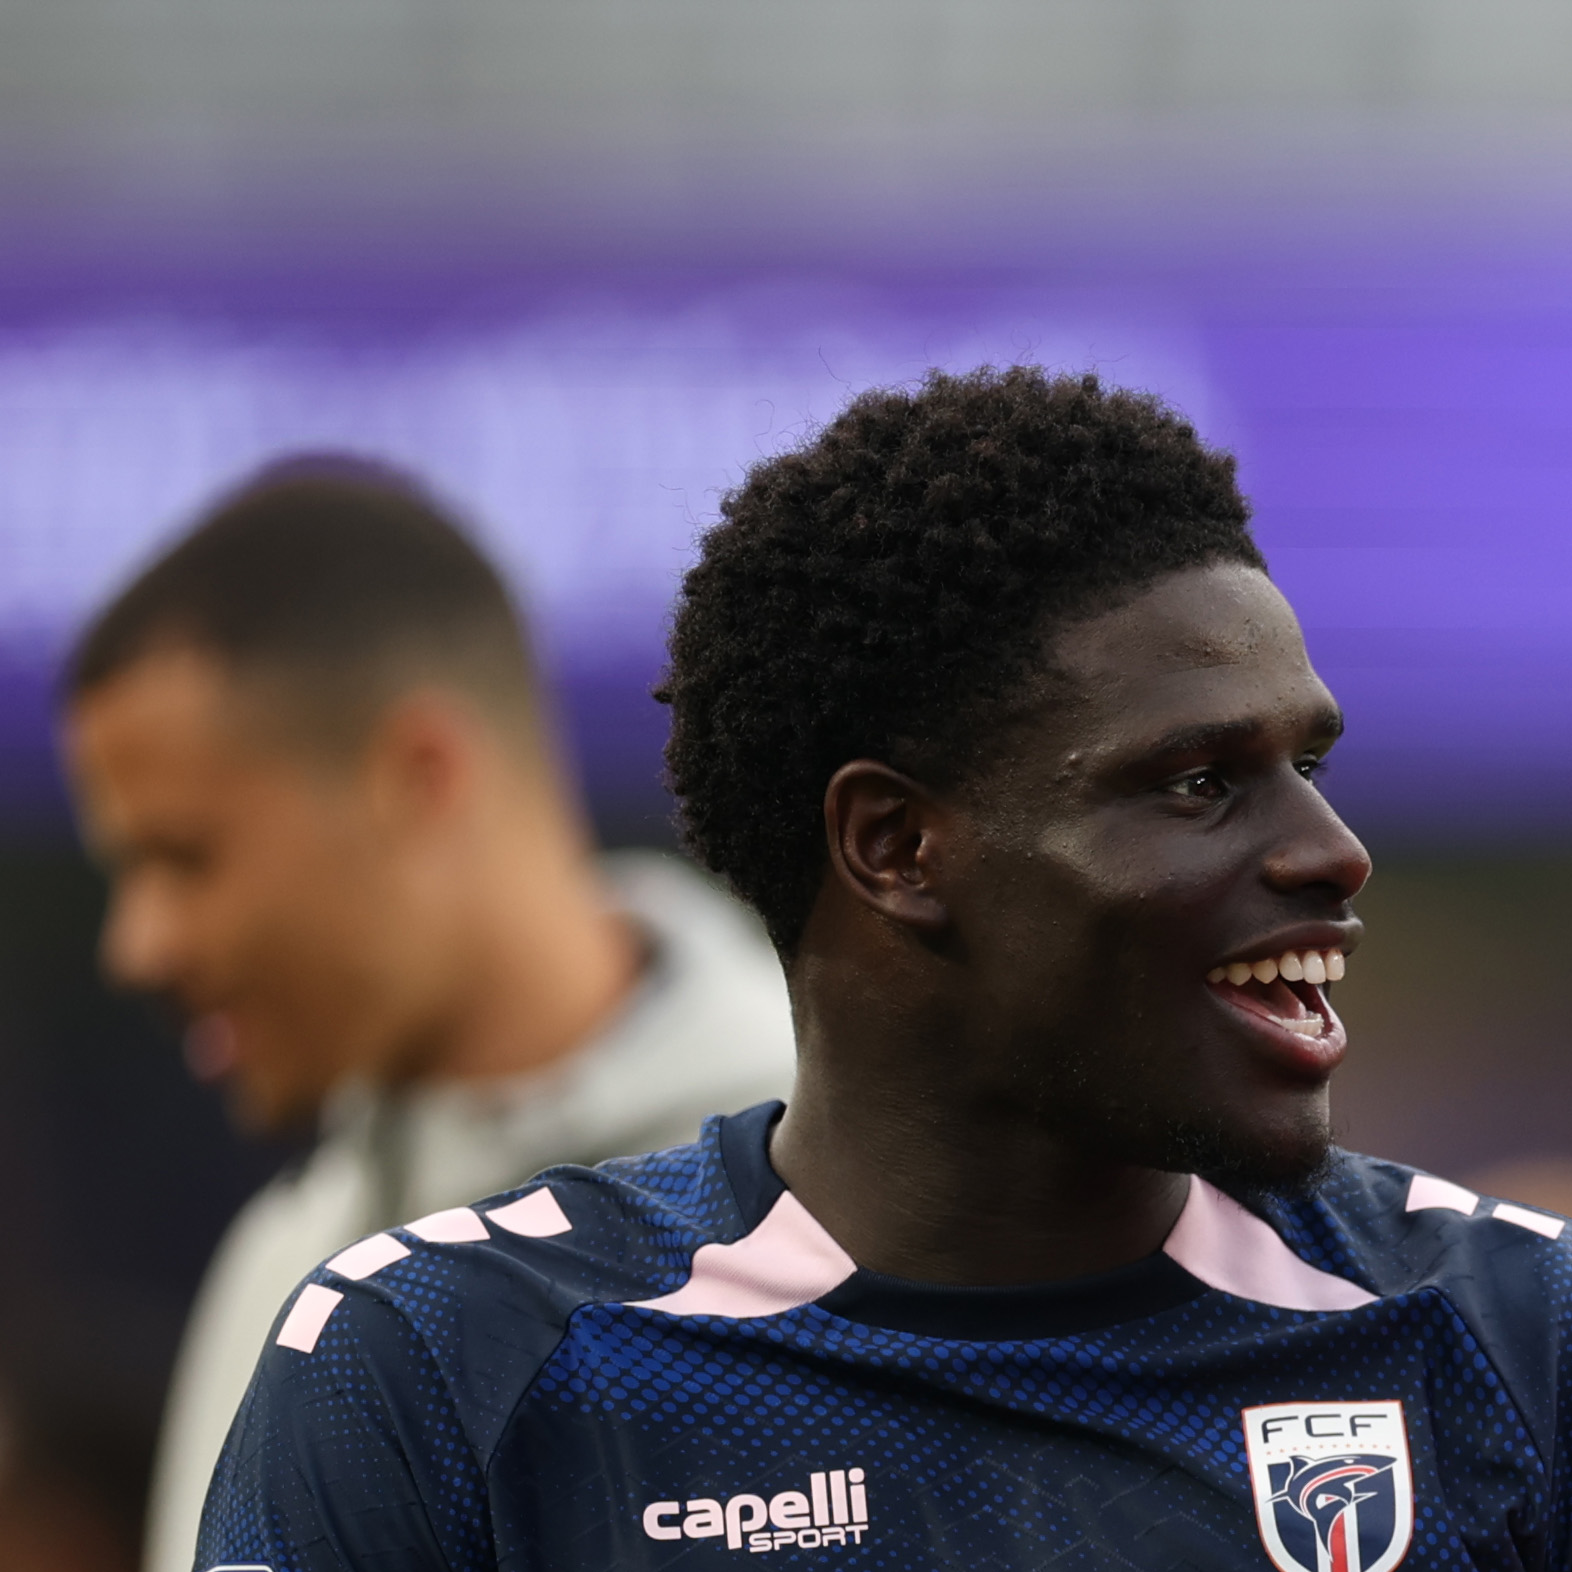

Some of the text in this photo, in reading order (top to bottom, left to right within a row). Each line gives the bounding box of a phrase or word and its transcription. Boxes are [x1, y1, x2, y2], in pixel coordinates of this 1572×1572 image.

[1261, 1413, 1388, 1444] FCF
[642, 1467, 868, 1550] capelli
[748, 1523, 869, 1553] SPORT
